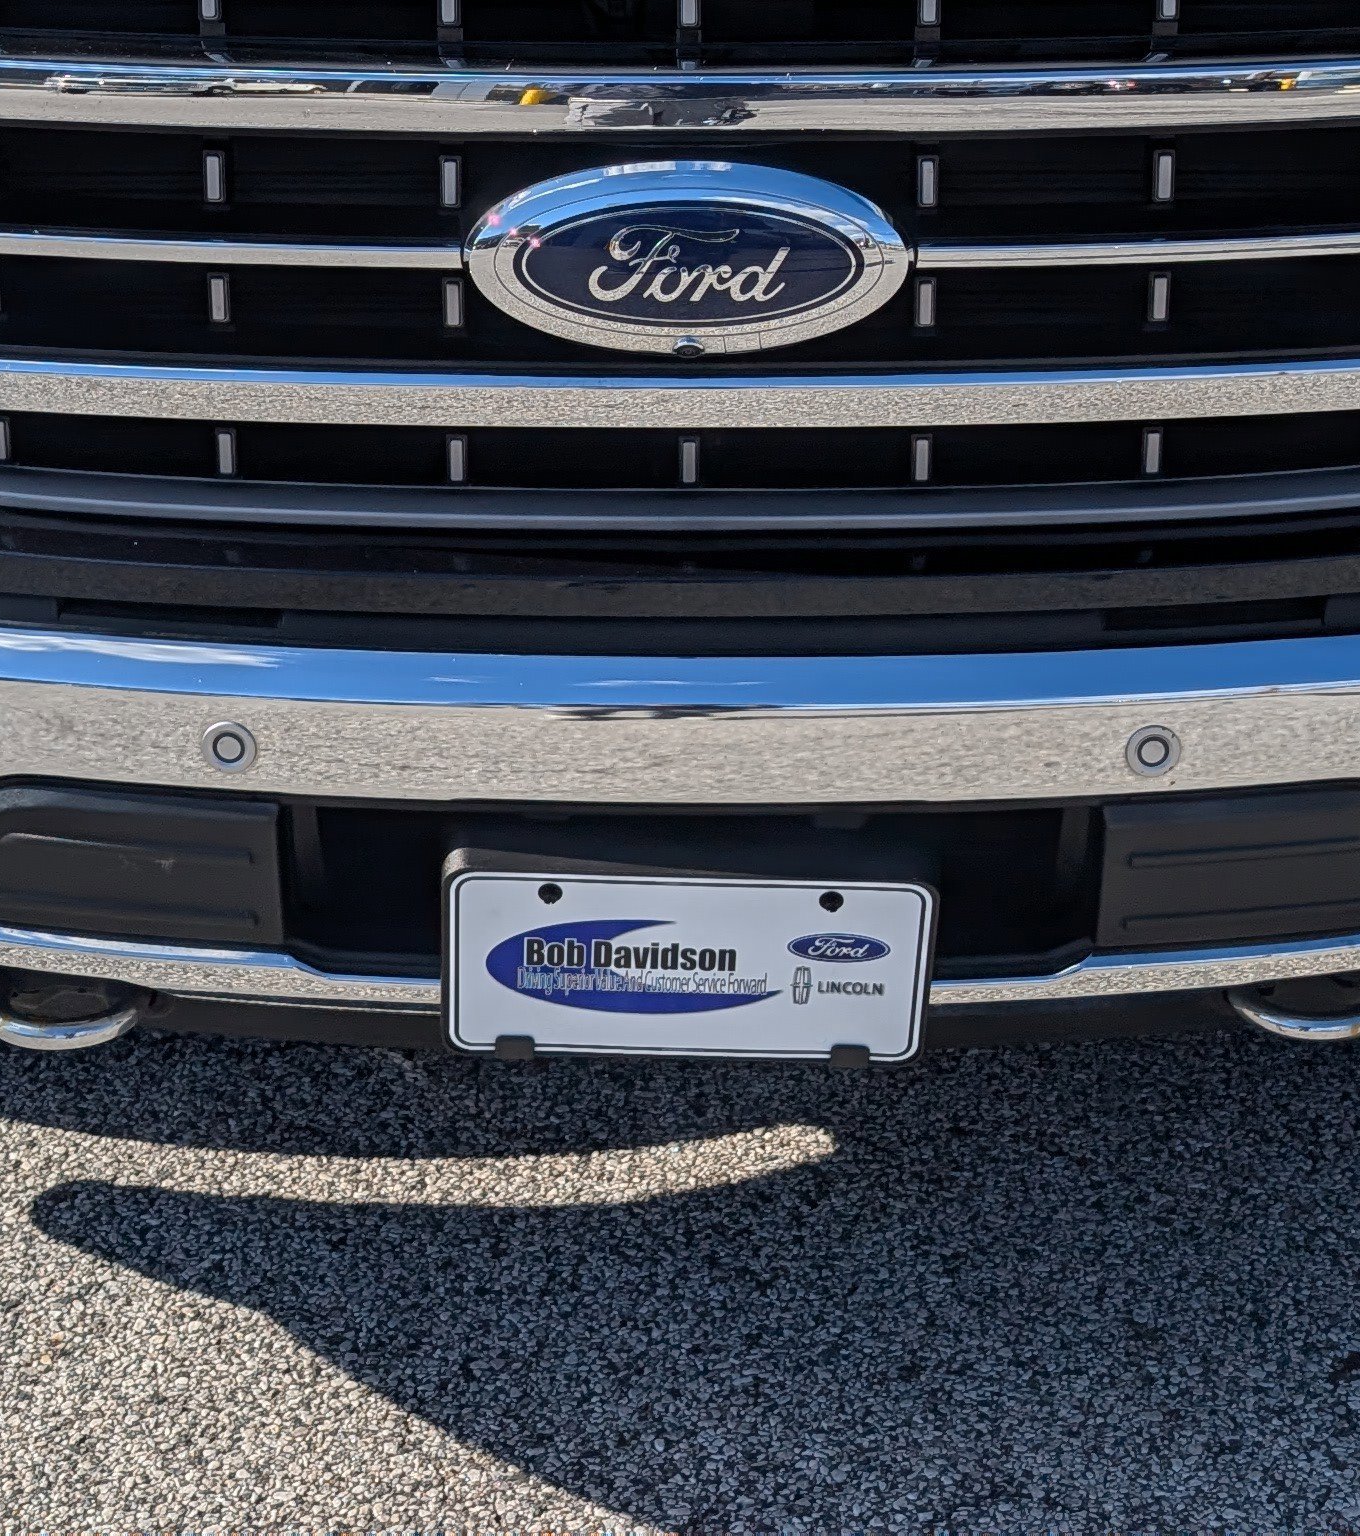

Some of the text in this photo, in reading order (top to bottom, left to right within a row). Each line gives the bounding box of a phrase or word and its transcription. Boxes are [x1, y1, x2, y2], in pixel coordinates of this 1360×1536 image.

[587, 223, 791, 302] Ford
[524, 937, 737, 971] Bob Davidson
[807, 937, 870, 958] Ford
[516, 965, 768, 997] Driving Superior Value And Customer Service Forward
[817, 980, 885, 997] LINCOLN
